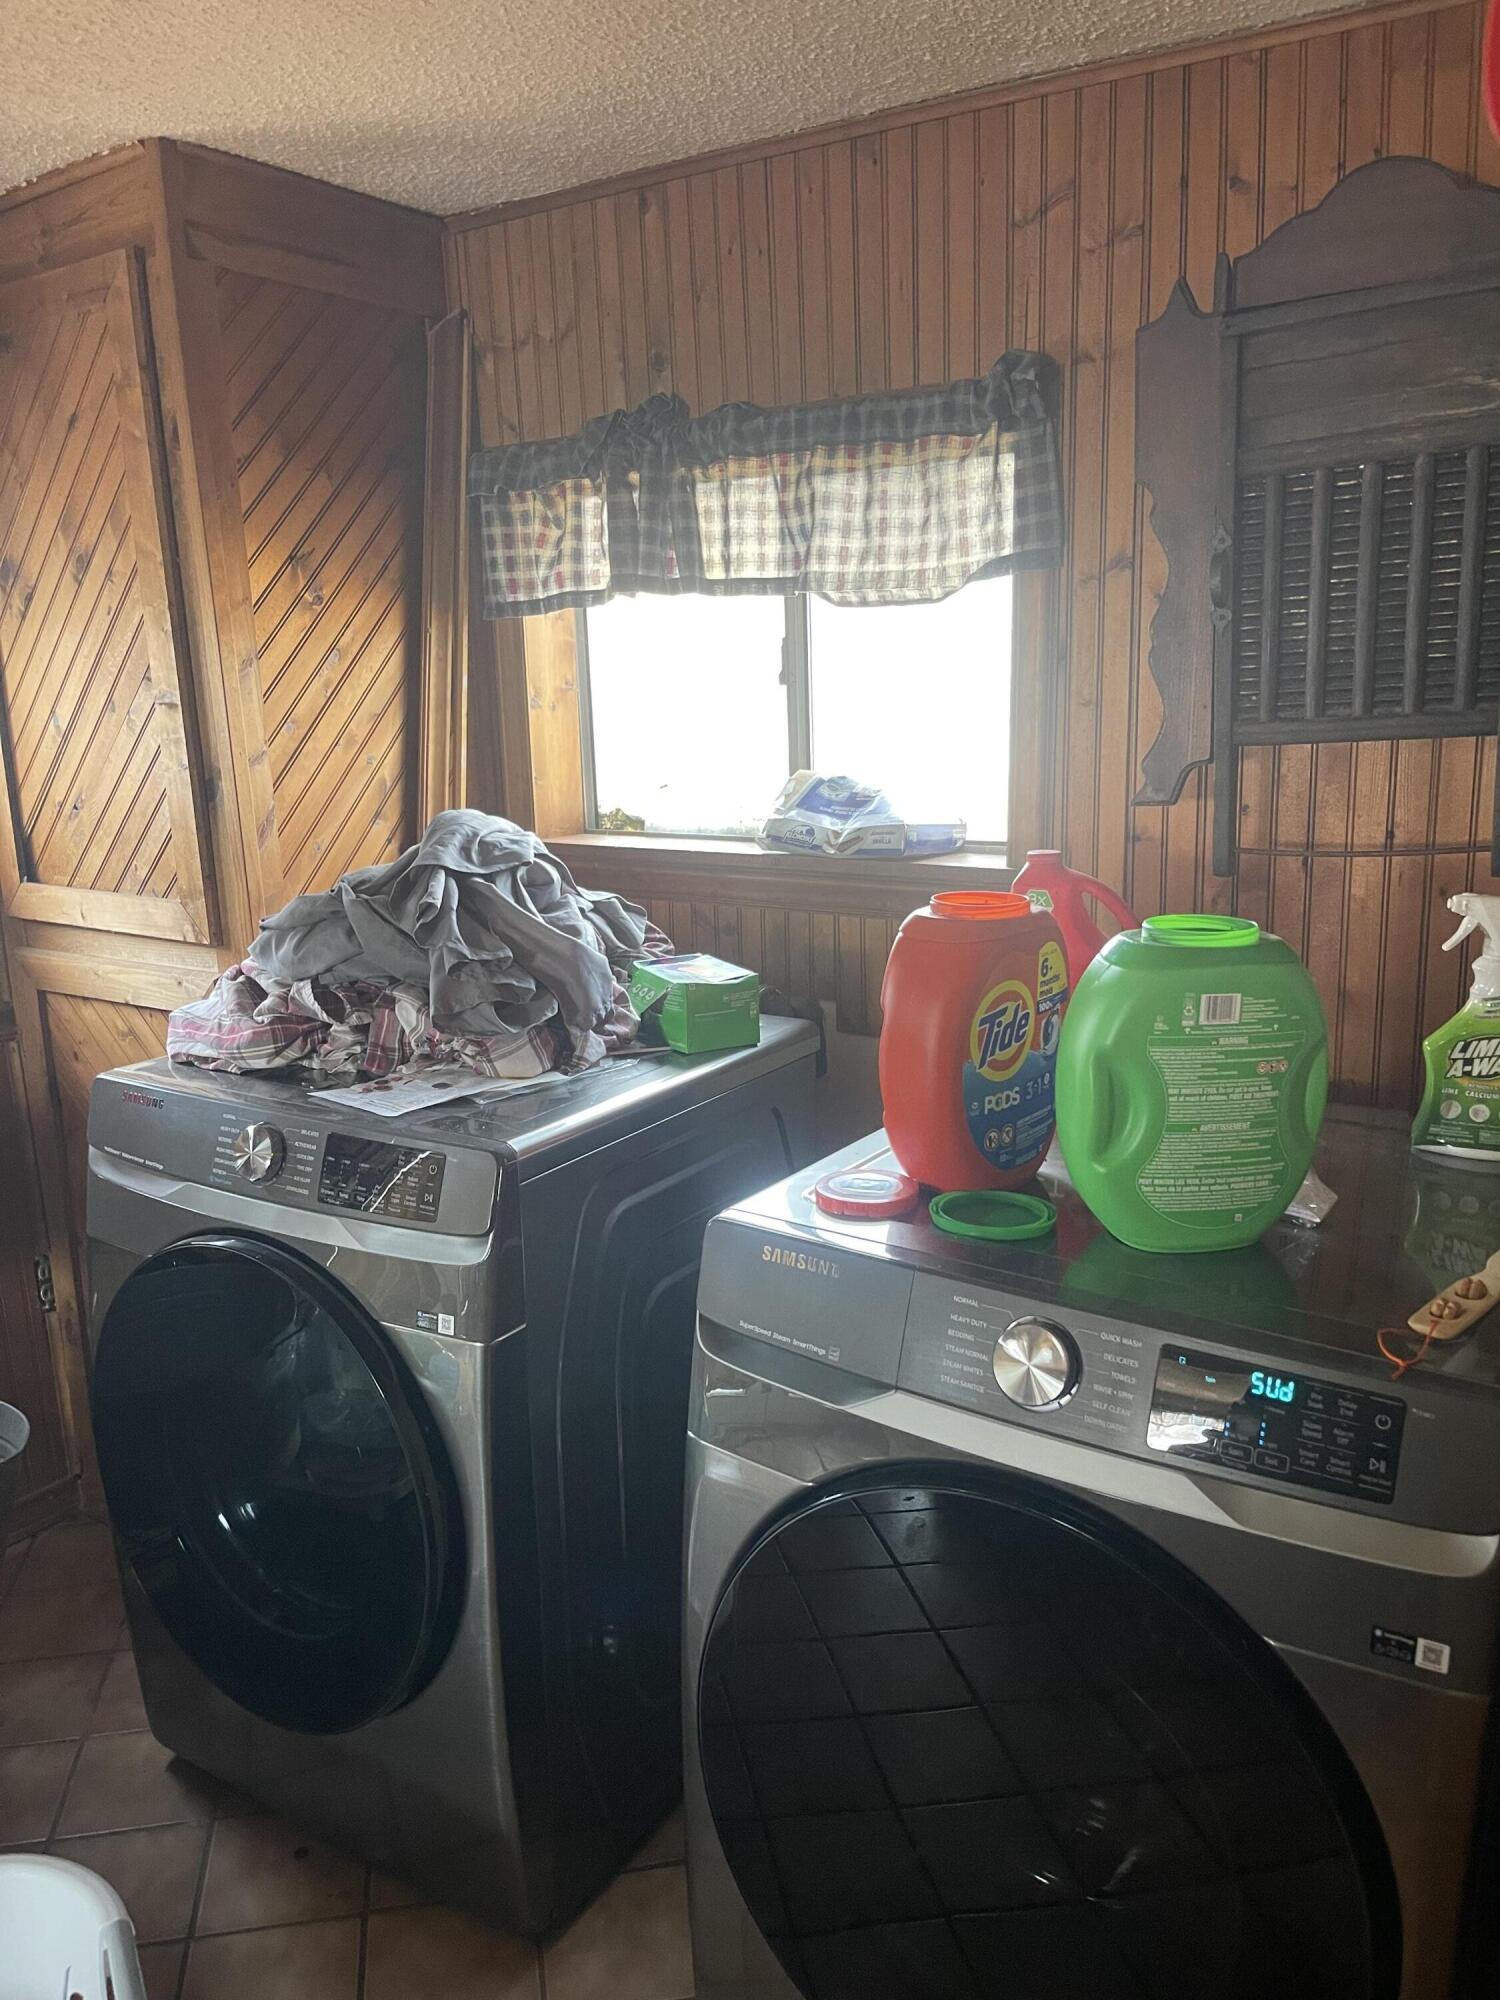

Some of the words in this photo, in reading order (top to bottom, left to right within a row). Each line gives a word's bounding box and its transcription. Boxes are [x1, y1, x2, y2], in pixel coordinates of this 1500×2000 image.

[976, 1000, 1030, 1072] Tide
[121, 1089, 165, 1110] SAMSUNG
[984, 1086, 1020, 1115] PODS
[762, 1246, 840, 1278] SAMSUNG
[953, 1296, 979, 1307] NORMAL
[949, 1313, 969, 1324] HEAVY
[970, 1319, 987, 1328] DUTY
[1100, 1332, 1120, 1342] QUICK
[1103, 1353, 1139, 1368] DELICATES
